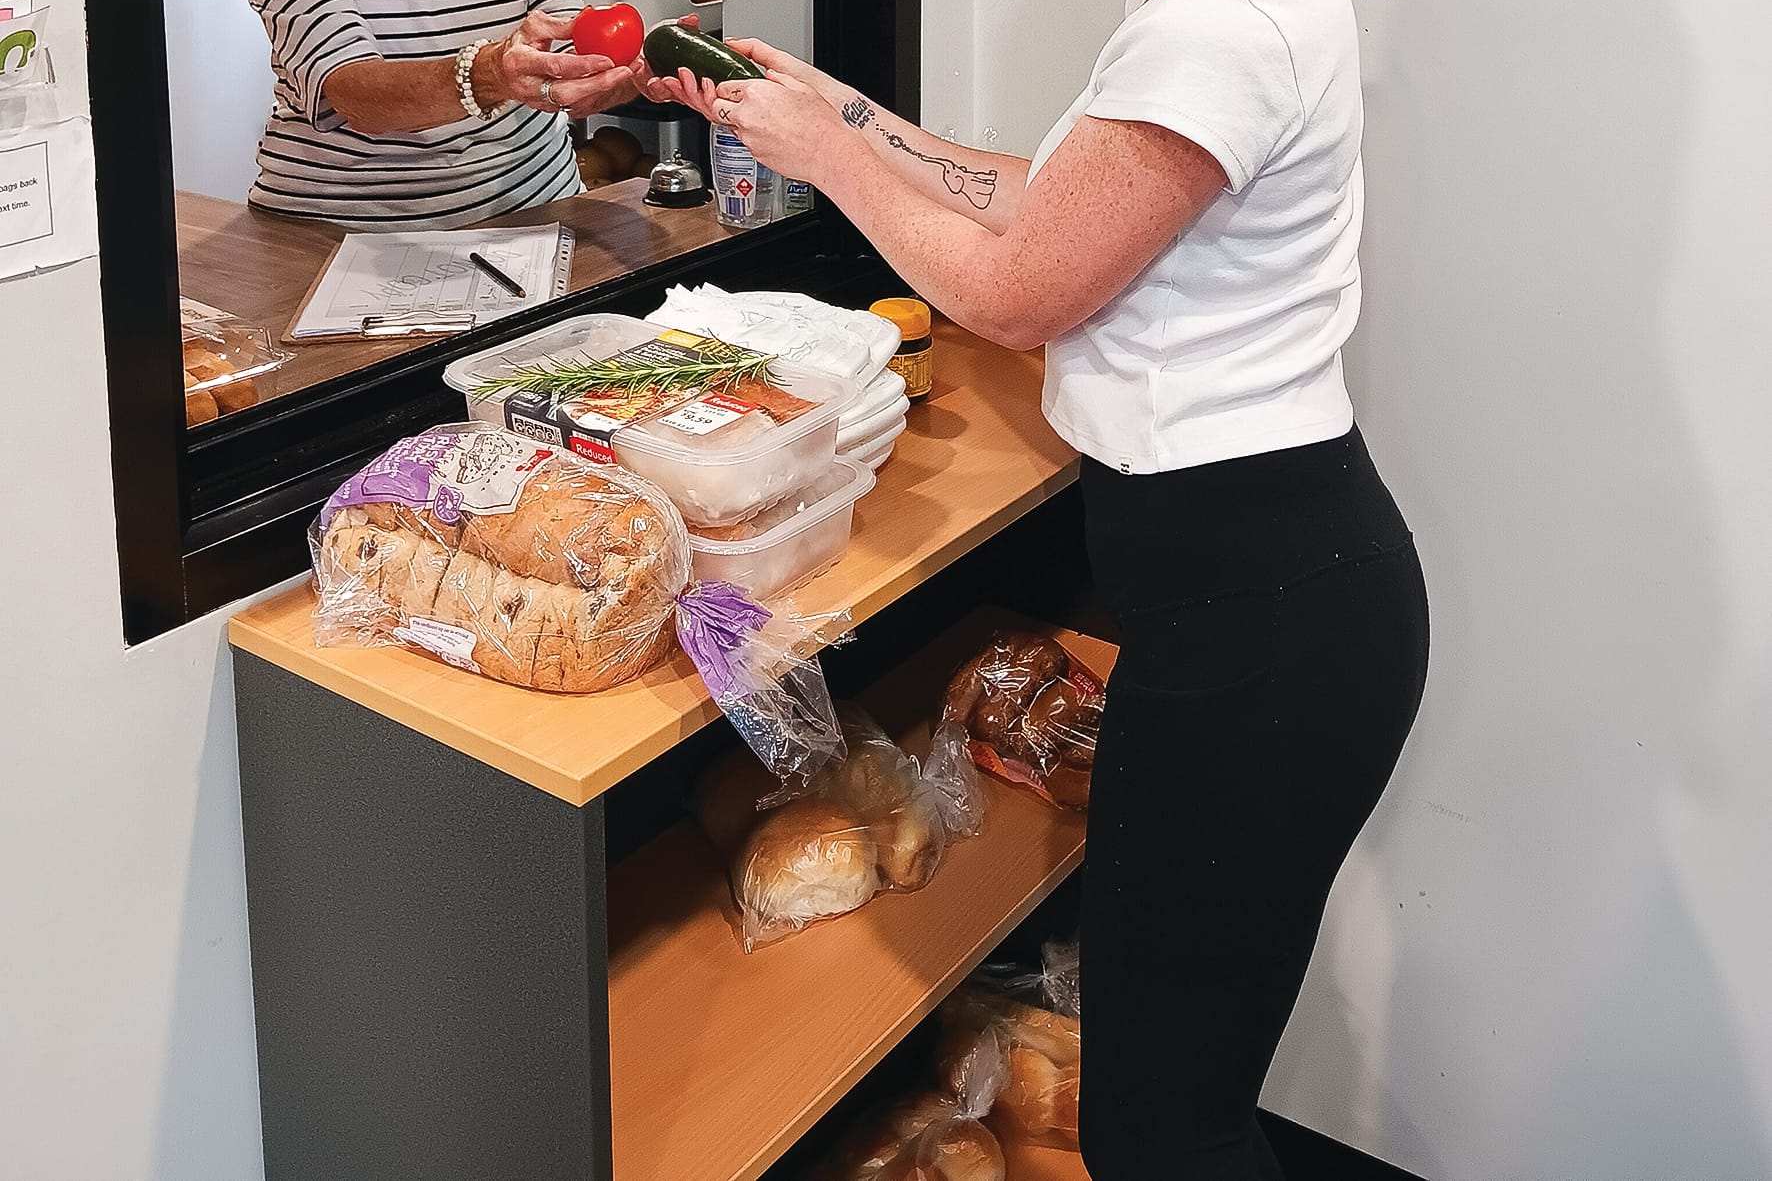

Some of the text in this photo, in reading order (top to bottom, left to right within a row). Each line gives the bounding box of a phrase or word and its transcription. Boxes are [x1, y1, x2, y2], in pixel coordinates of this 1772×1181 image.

[19, 177, 38, 188] back
[709, 397, 752, 412] Reduced
[575, 443, 613, 463] Reduced
